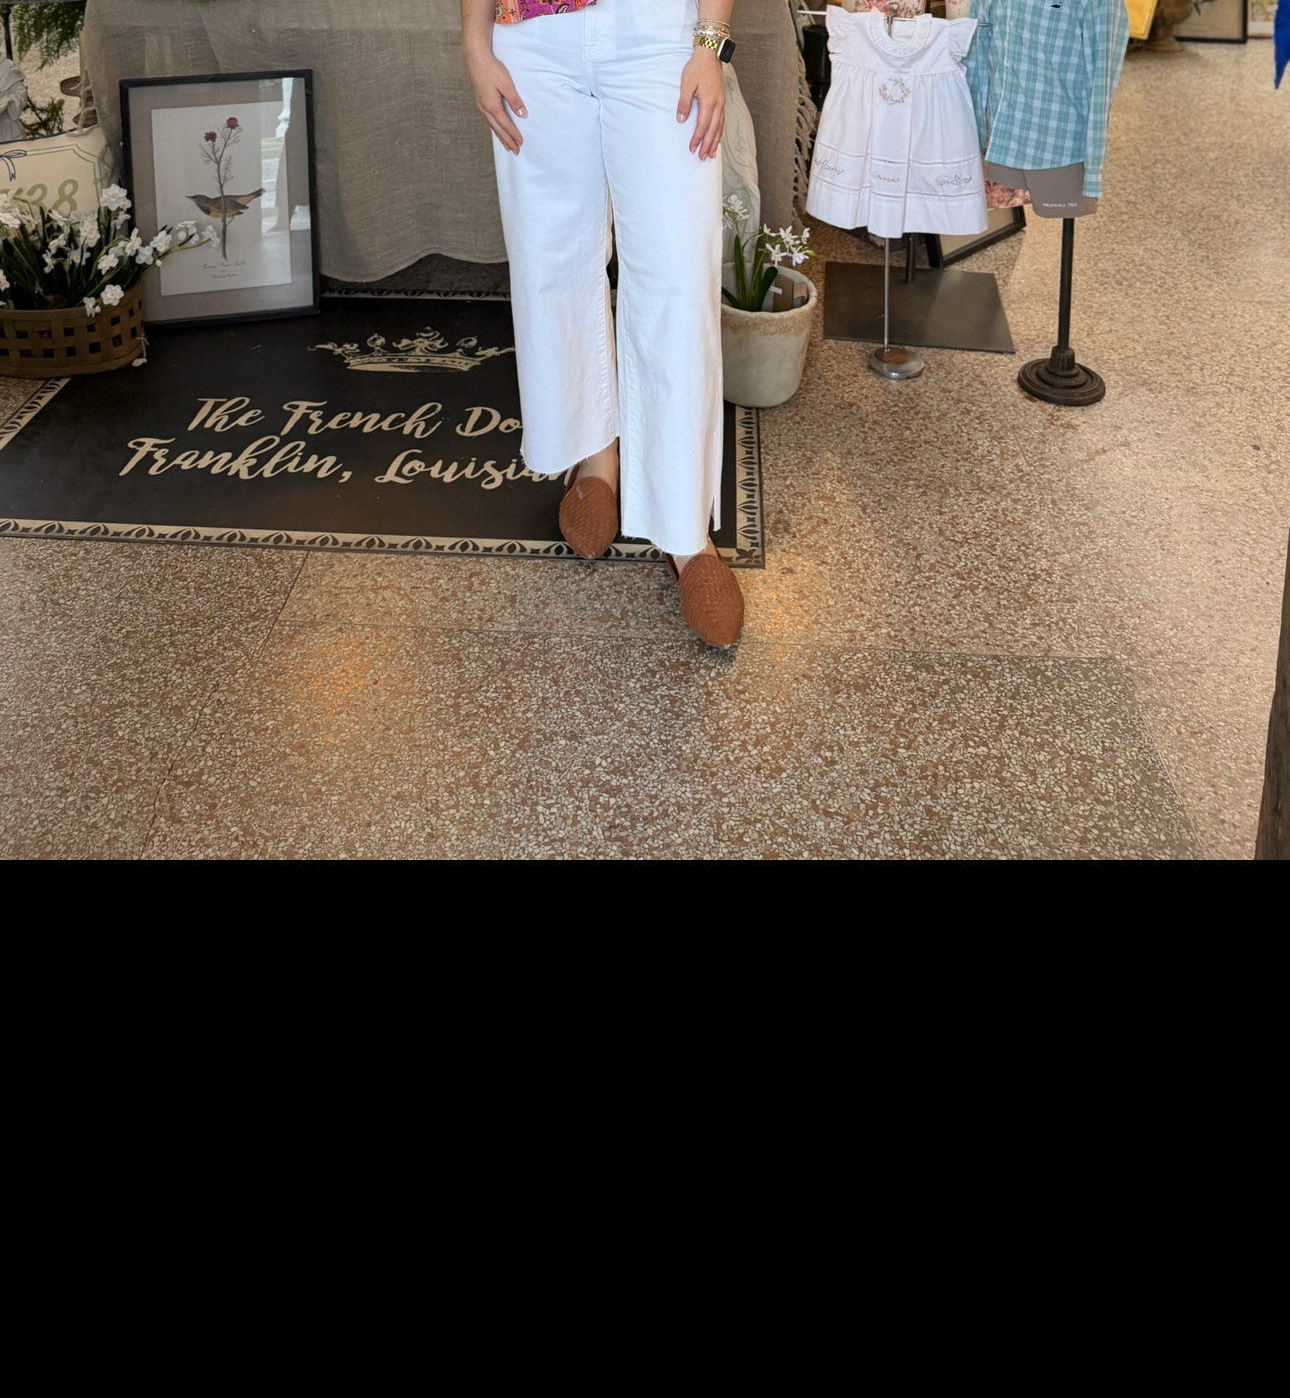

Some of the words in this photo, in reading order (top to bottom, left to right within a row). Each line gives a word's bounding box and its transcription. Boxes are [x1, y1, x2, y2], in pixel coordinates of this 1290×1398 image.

[187, 396, 265, 432] The
[280, 400, 442, 439] French
[455, 406, 523, 437] Do
[118, 434, 353, 483] Franklin,
